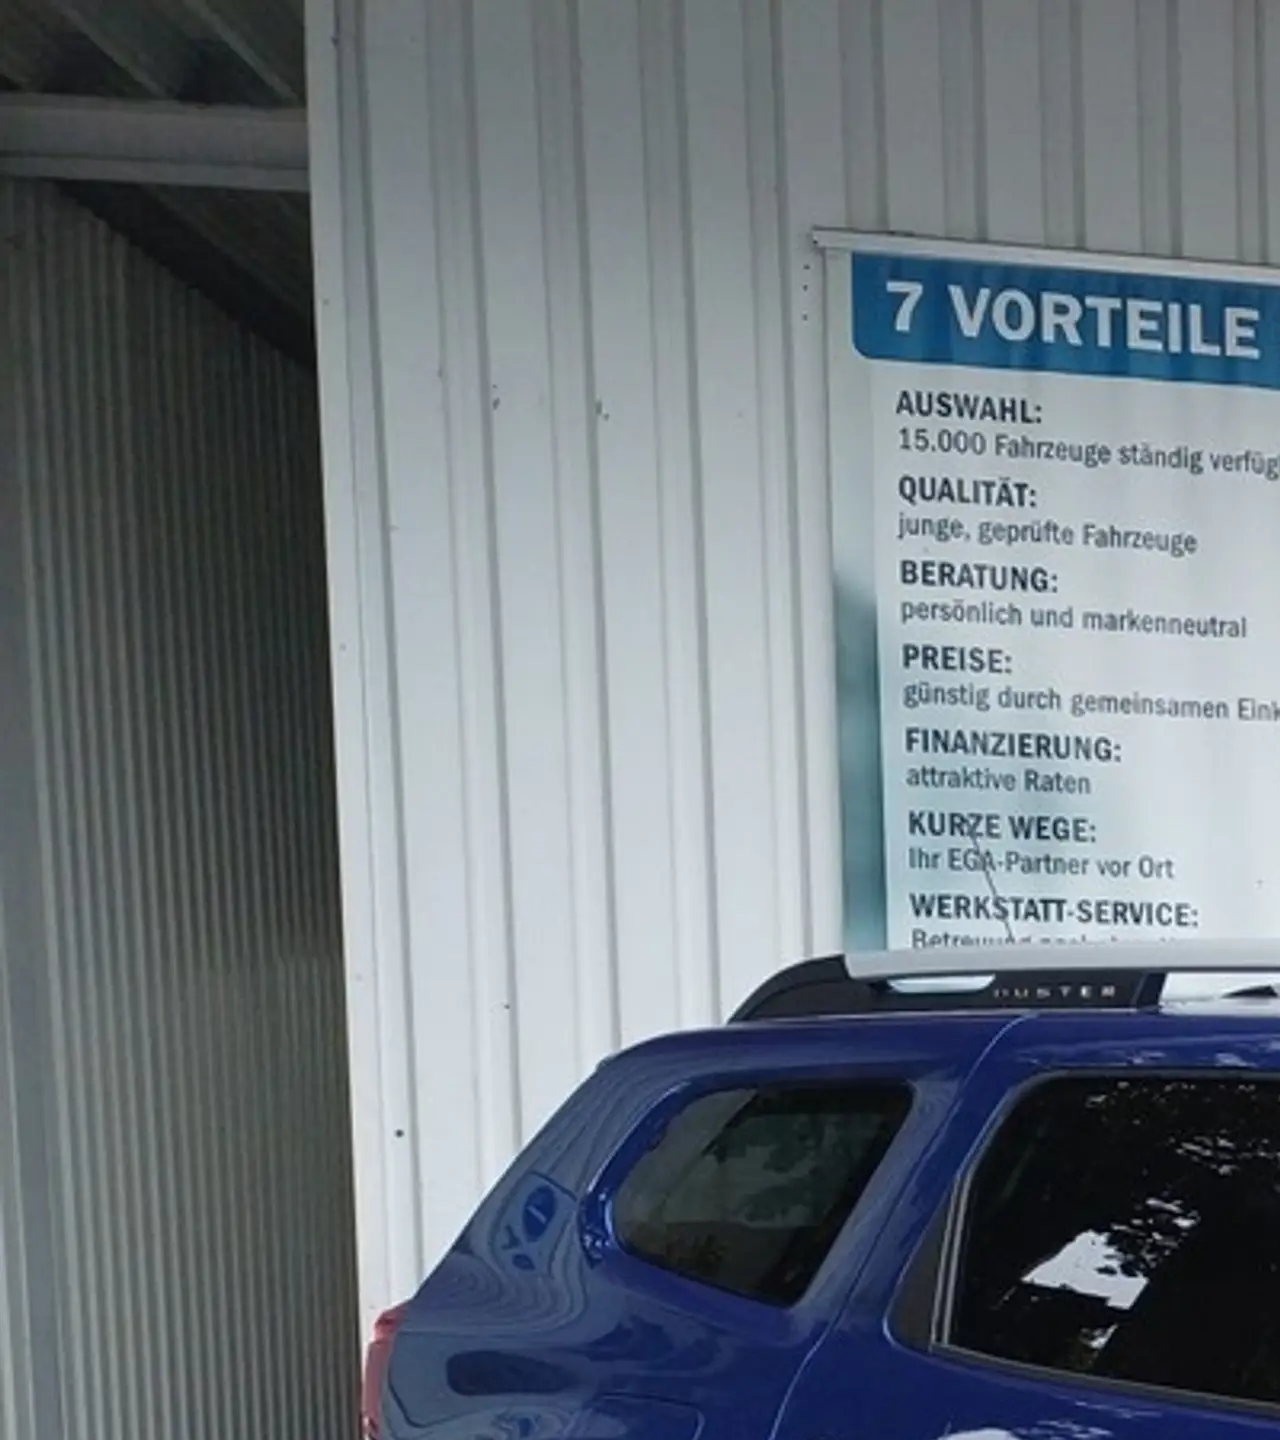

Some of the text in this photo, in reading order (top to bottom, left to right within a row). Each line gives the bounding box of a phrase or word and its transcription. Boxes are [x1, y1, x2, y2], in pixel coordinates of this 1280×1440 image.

[886, 281, 922, 332] 7
[949, 284, 1259, 358] VORTEILE
[896, 390, 1042, 424] AUSWAHL:
[898, 428, 987, 456] 15.000
[995, 432, 1112, 467] Fahrzeuge
[1118, 443, 1204, 475] ständig
[898, 476, 1038, 508] QUALITÄT:
[897, 516, 1197, 556] junge, geprüfte Fahrzeuge
[901, 560, 1058, 594] BERATUNG:
[900, 599, 1248, 638] persönlich und markenneutral
[902, 644, 1012, 674] PREISE:
[903, 683, 990, 711] günstig
[998, 686, 1061, 711] durch
[1071, 693, 1229, 720] gemeinsamen
[905, 728, 1122, 762] FINANZIERUNG:
[905, 767, 1091, 794] attraktive Raten
[908, 811, 1097, 843] KURZE WEGE:
[908, 847, 1175, 880] Ihr EGA-Partner vor Ort
[909, 893, 1199, 927] WERKSTATT-SERVICE:
